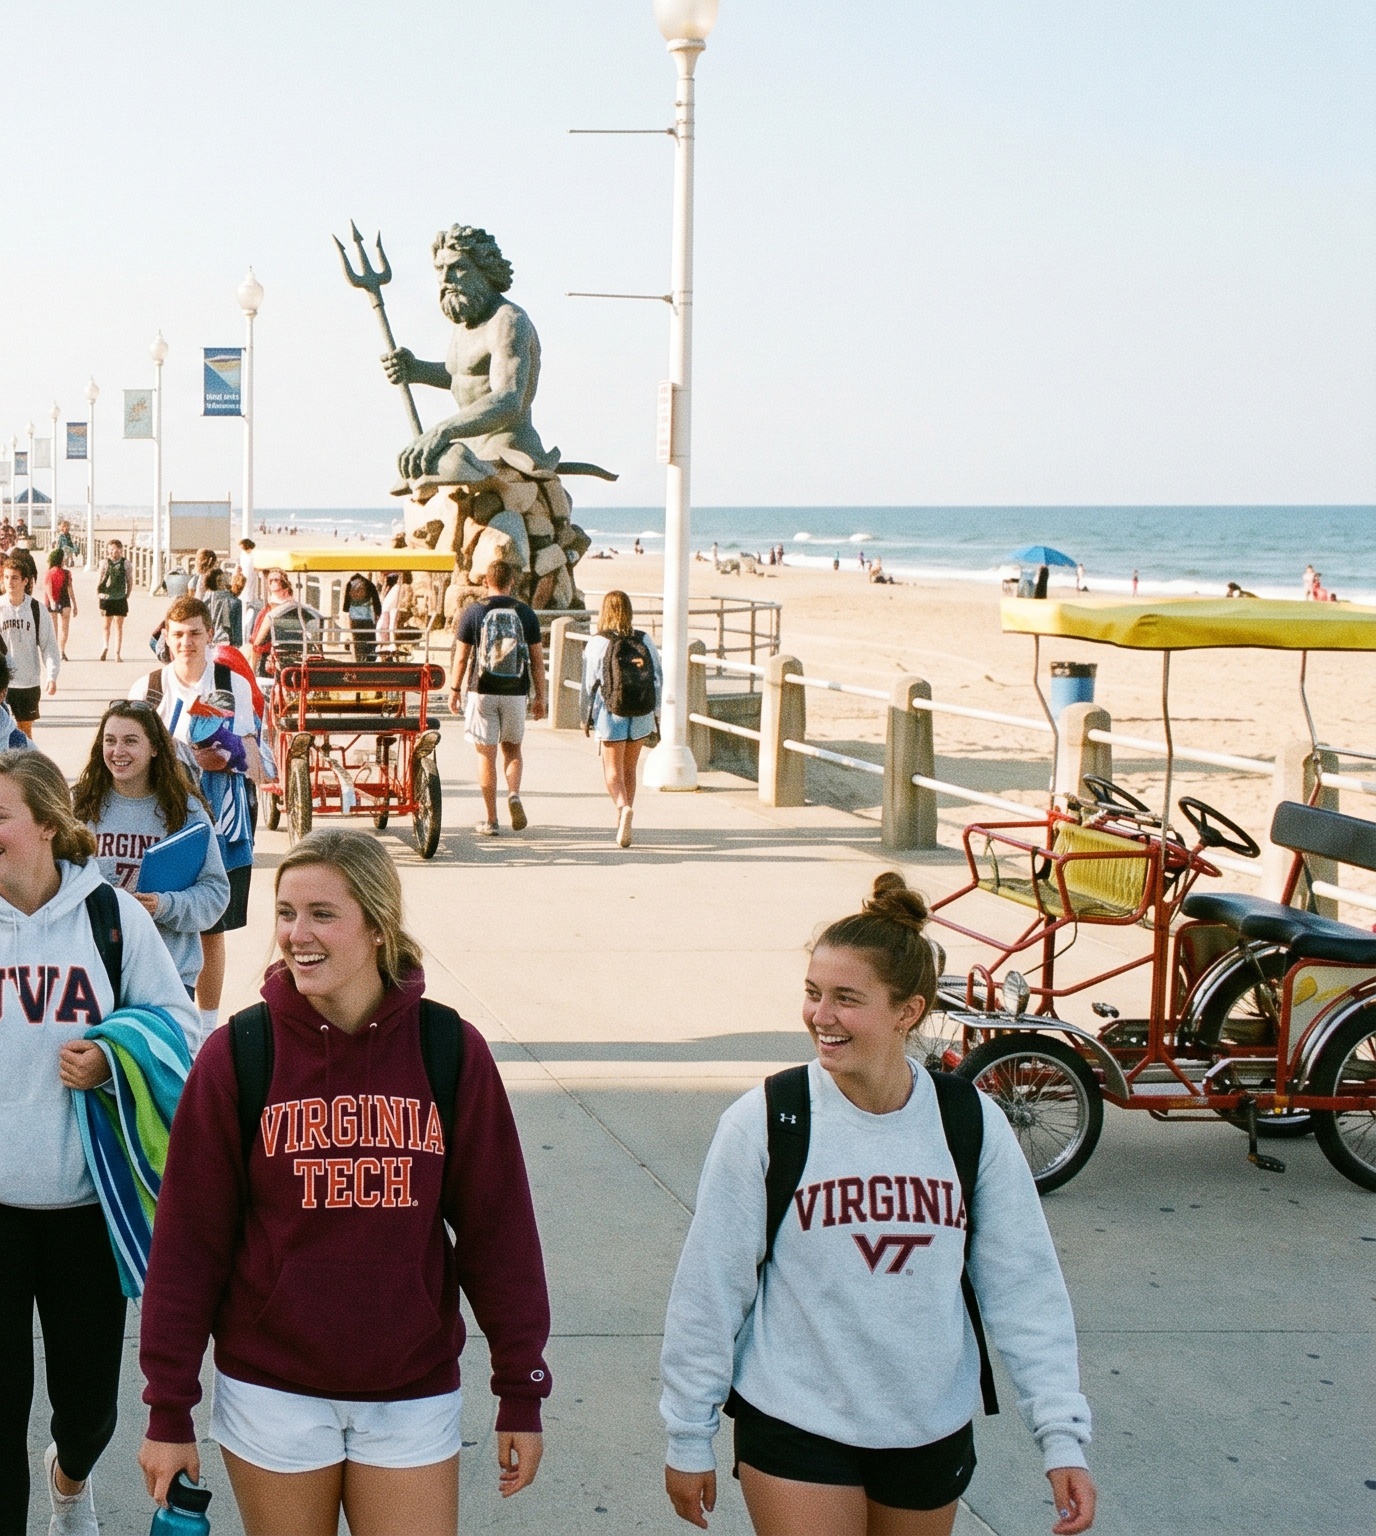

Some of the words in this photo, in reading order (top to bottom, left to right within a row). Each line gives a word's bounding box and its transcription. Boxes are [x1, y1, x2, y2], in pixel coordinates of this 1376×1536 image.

[260, 1094, 446, 1158] VIRGINIA
[293, 1156, 413, 1209] TECH
[850, 1233, 936, 1275] VT
